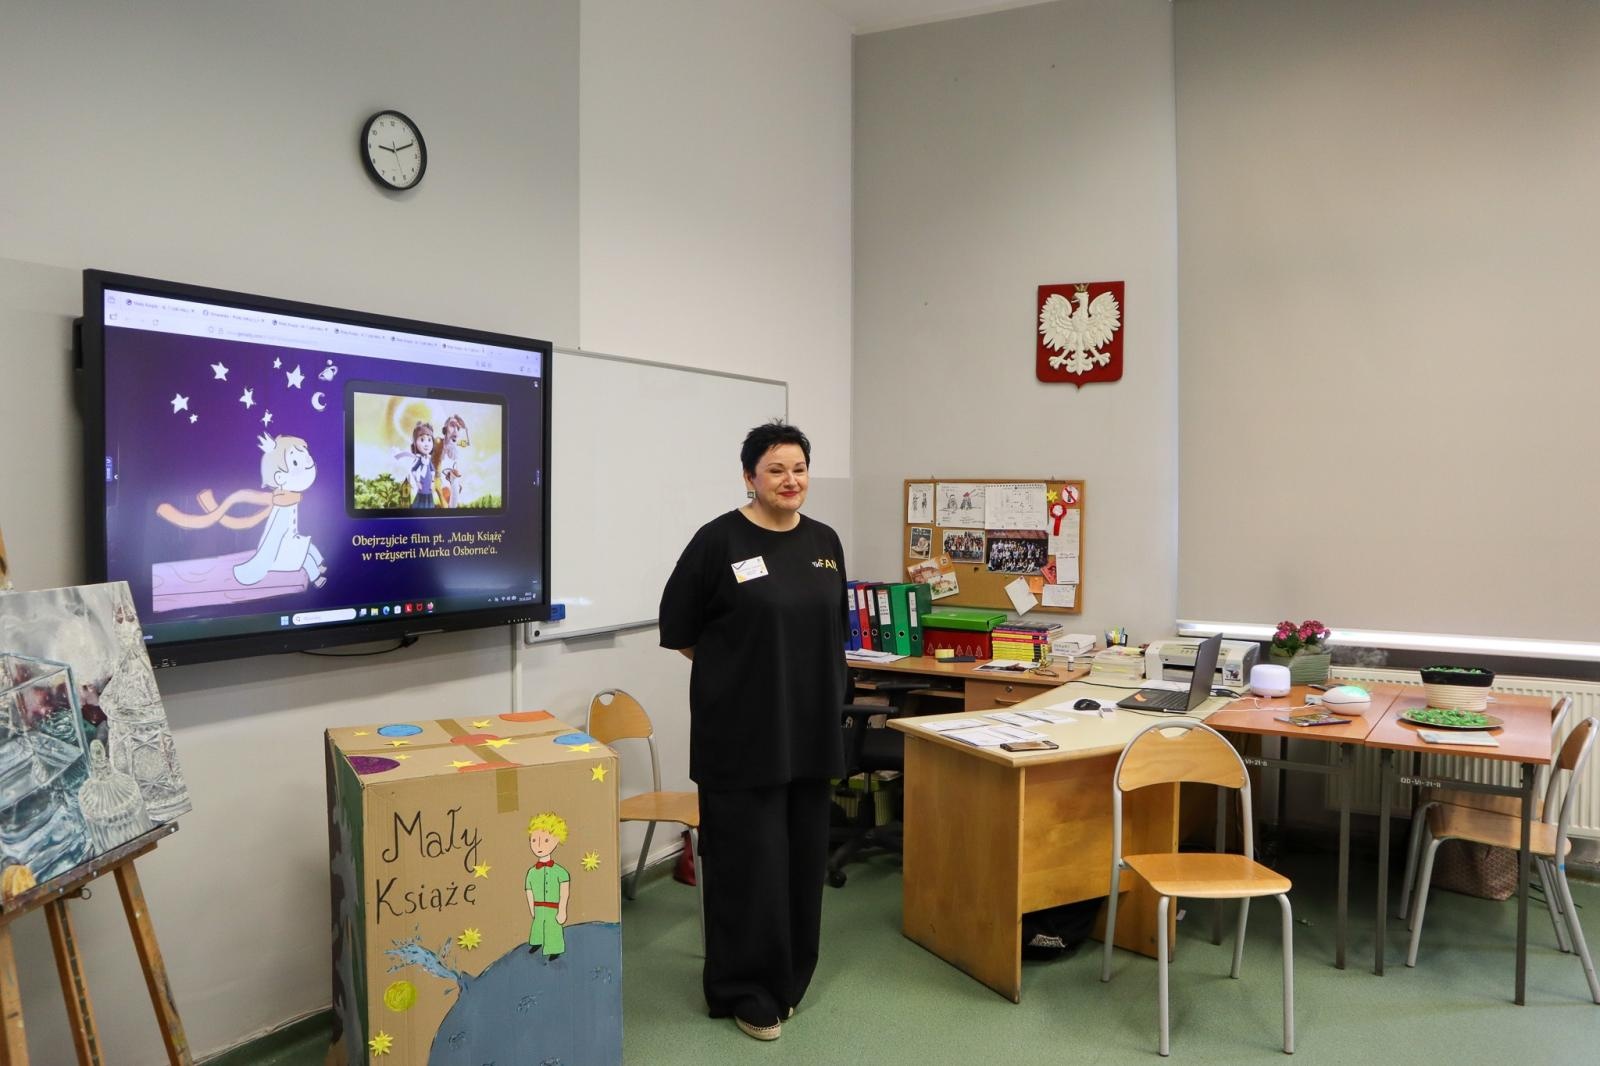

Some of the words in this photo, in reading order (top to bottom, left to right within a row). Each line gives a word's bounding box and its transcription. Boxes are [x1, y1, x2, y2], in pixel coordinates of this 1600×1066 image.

[352, 534, 408, 548] Obejrzyjcie
[411, 533, 430, 544] film
[433, 534, 445, 546] pt.
[362, 552, 372, 561] w
[375, 548, 416, 563] reżyserii
[419, 547, 450, 558] Marka
[381, 806, 483, 873] Mały
[373, 877, 478, 925] Książę
